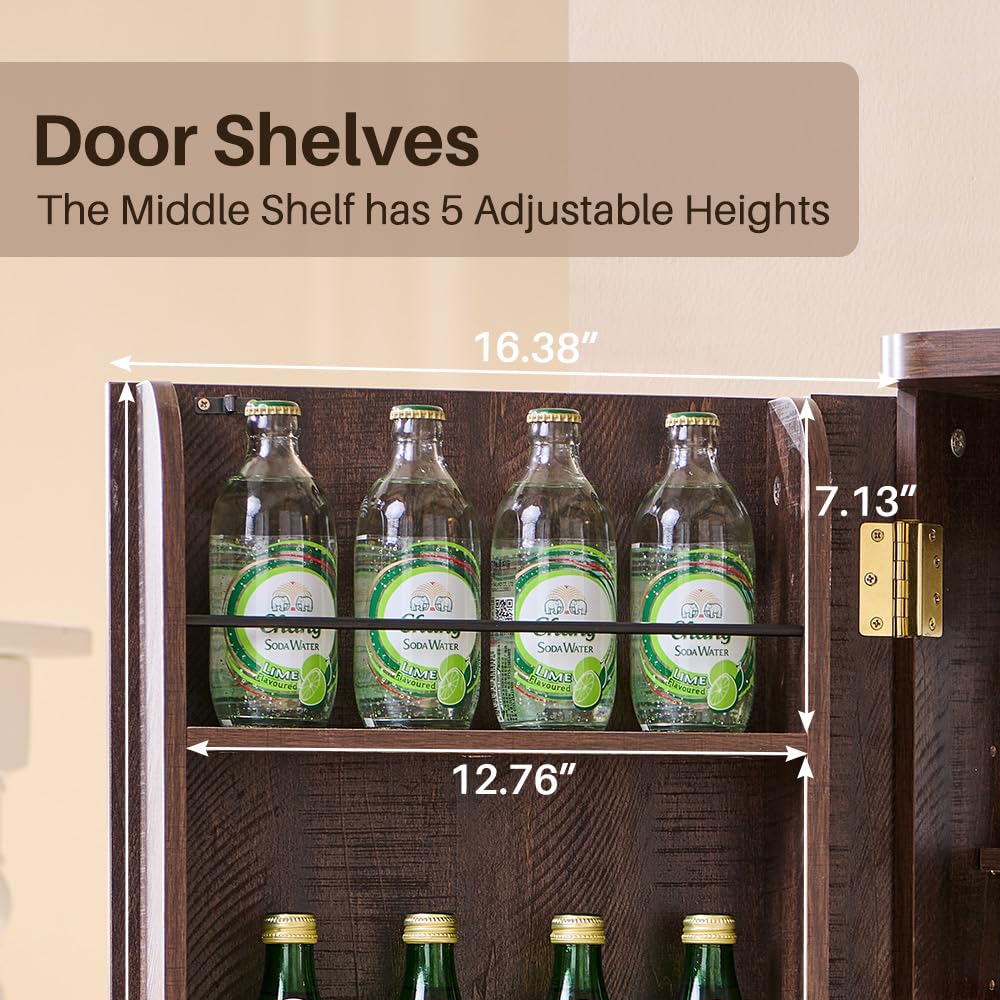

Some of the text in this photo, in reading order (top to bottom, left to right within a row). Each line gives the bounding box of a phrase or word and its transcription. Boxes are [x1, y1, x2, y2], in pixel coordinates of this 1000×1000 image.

[264, 639, 320, 651] SODA WATER
[403, 638, 459, 651] SODA WATER
[537, 641, 594, 653] SODA WATER
[674, 645, 729, 657] SODA WATER
[262, 662, 299, 680] LIME
[401, 661, 437, 680] LIME
[535, 664, 573, 683] LIME
[673, 668, 707, 686] LIME
[256, 673, 298, 690] Flavoured
[395, 672, 436, 690] Flavoured
[529, 675, 571, 693] Flavoured
[667, 678, 706, 696] Flavoured
